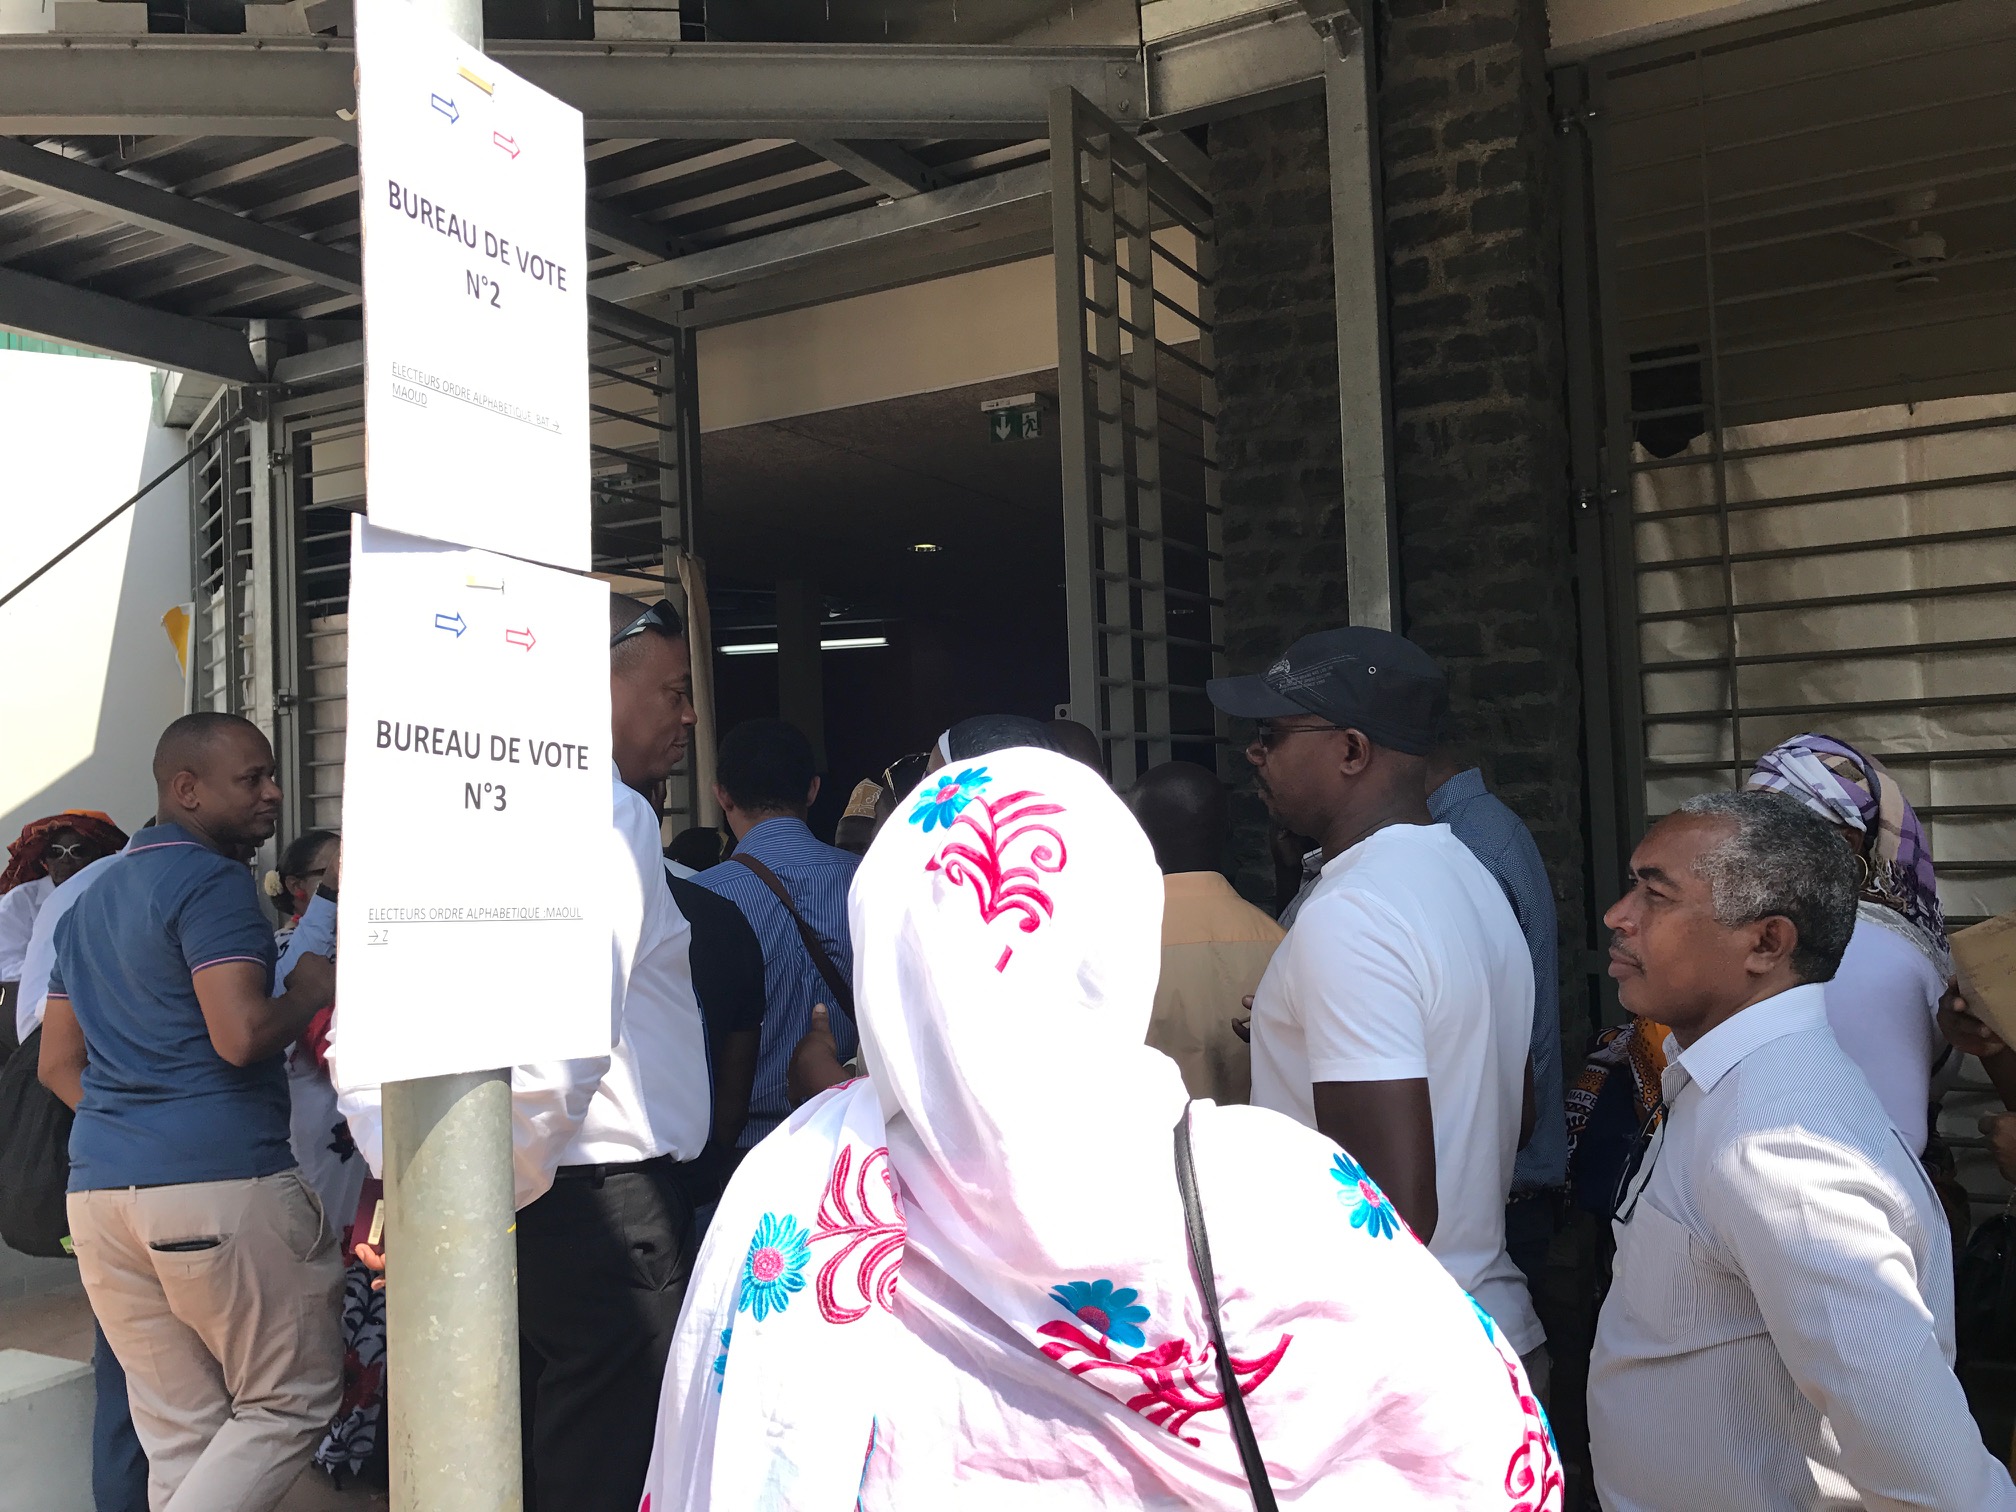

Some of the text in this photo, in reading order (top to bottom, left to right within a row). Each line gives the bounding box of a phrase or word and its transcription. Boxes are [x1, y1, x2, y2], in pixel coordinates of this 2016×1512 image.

[388, 179, 567, 293] BUREAU DE VOTE
[466, 268, 502, 310] N°2
[391, 361, 441, 390] ELECTEURS
[442, 380, 471, 401] ORDRE
[473, 392, 532, 421] ALPHABETIQUE
[391, 382, 428, 405] MAOUD
[376, 719, 589, 771] BUREAU DE VOTE
[464, 781, 507, 812] N°3
[368, 907, 426, 921] ELECTEURS
[428, 907, 464, 920] ORDRE
[465, 906, 540, 920] ALPHABETIQUE
